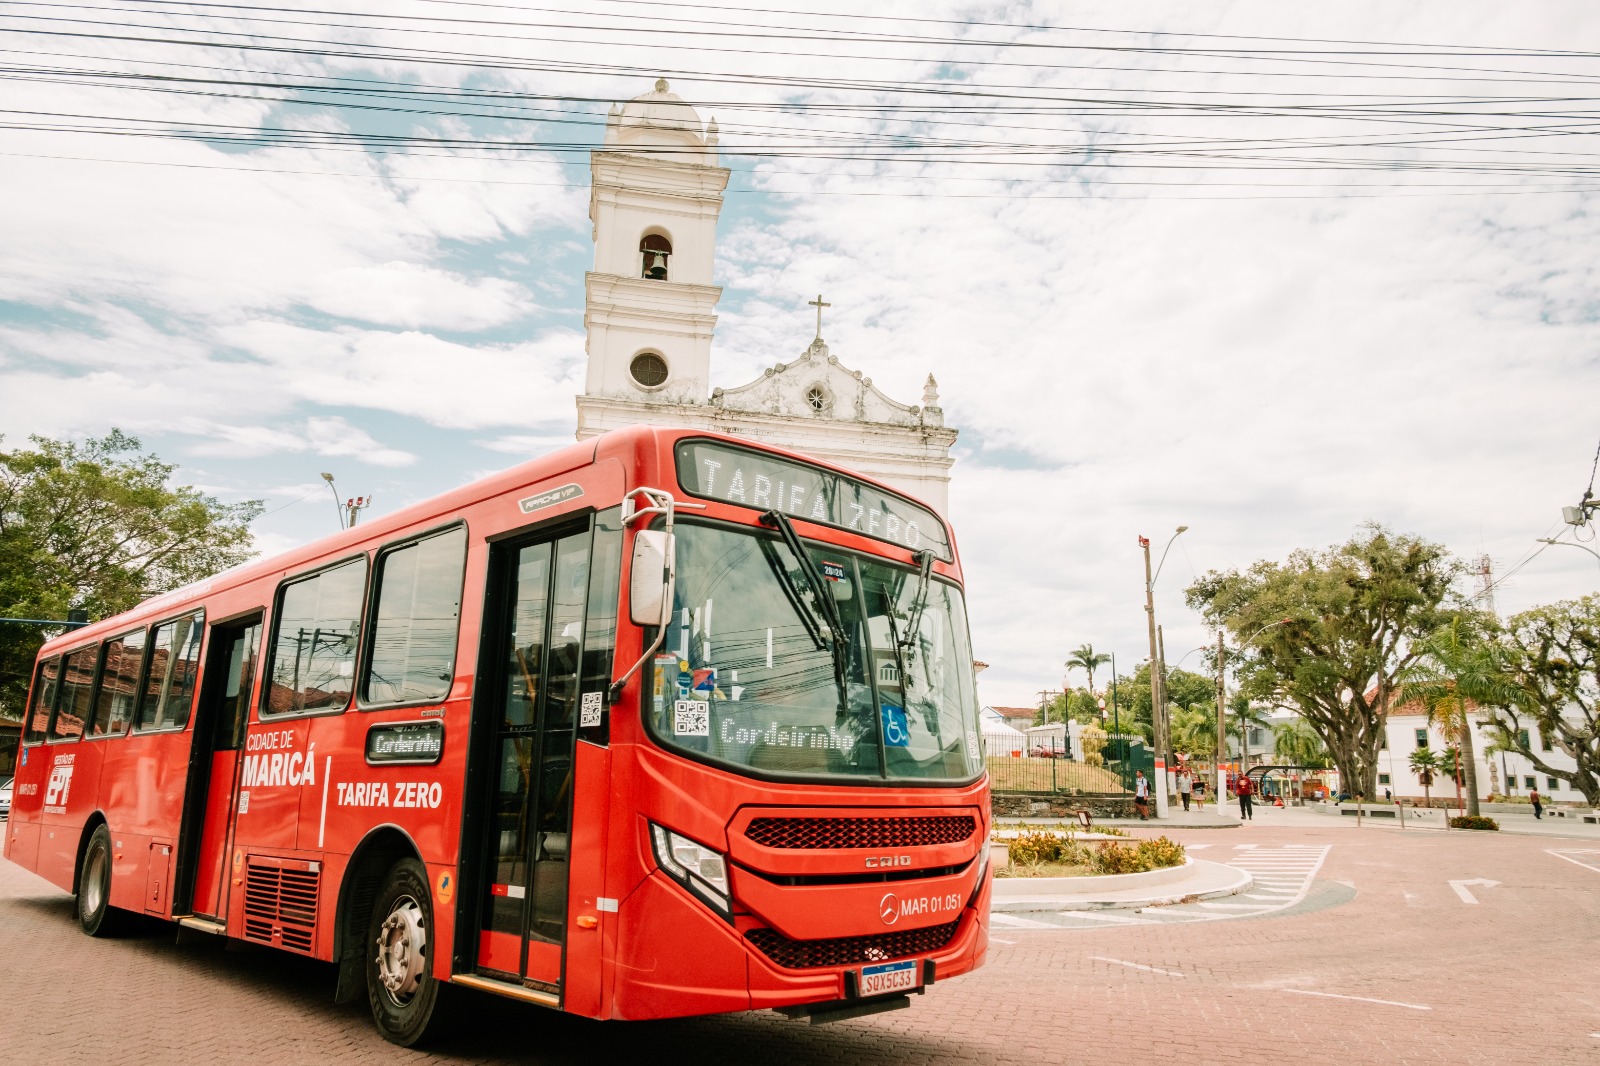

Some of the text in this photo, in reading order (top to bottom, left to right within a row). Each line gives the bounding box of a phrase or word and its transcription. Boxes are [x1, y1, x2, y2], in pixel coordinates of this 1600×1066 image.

[561, 487, 575, 497] VIP
[704, 459, 920, 548] TARIFA ZERO
[247, 729, 294, 751] CIDADE DE
[721, 718, 854, 750] Cordeirinho
[241, 742, 315, 787] MARICÁ
[337, 782, 442, 808] TARIFA ZERO
[865, 855, 911, 868] CAIO
[901, 893, 961, 916] MAR 01.051
[866, 970, 911, 992] SQX5C33
